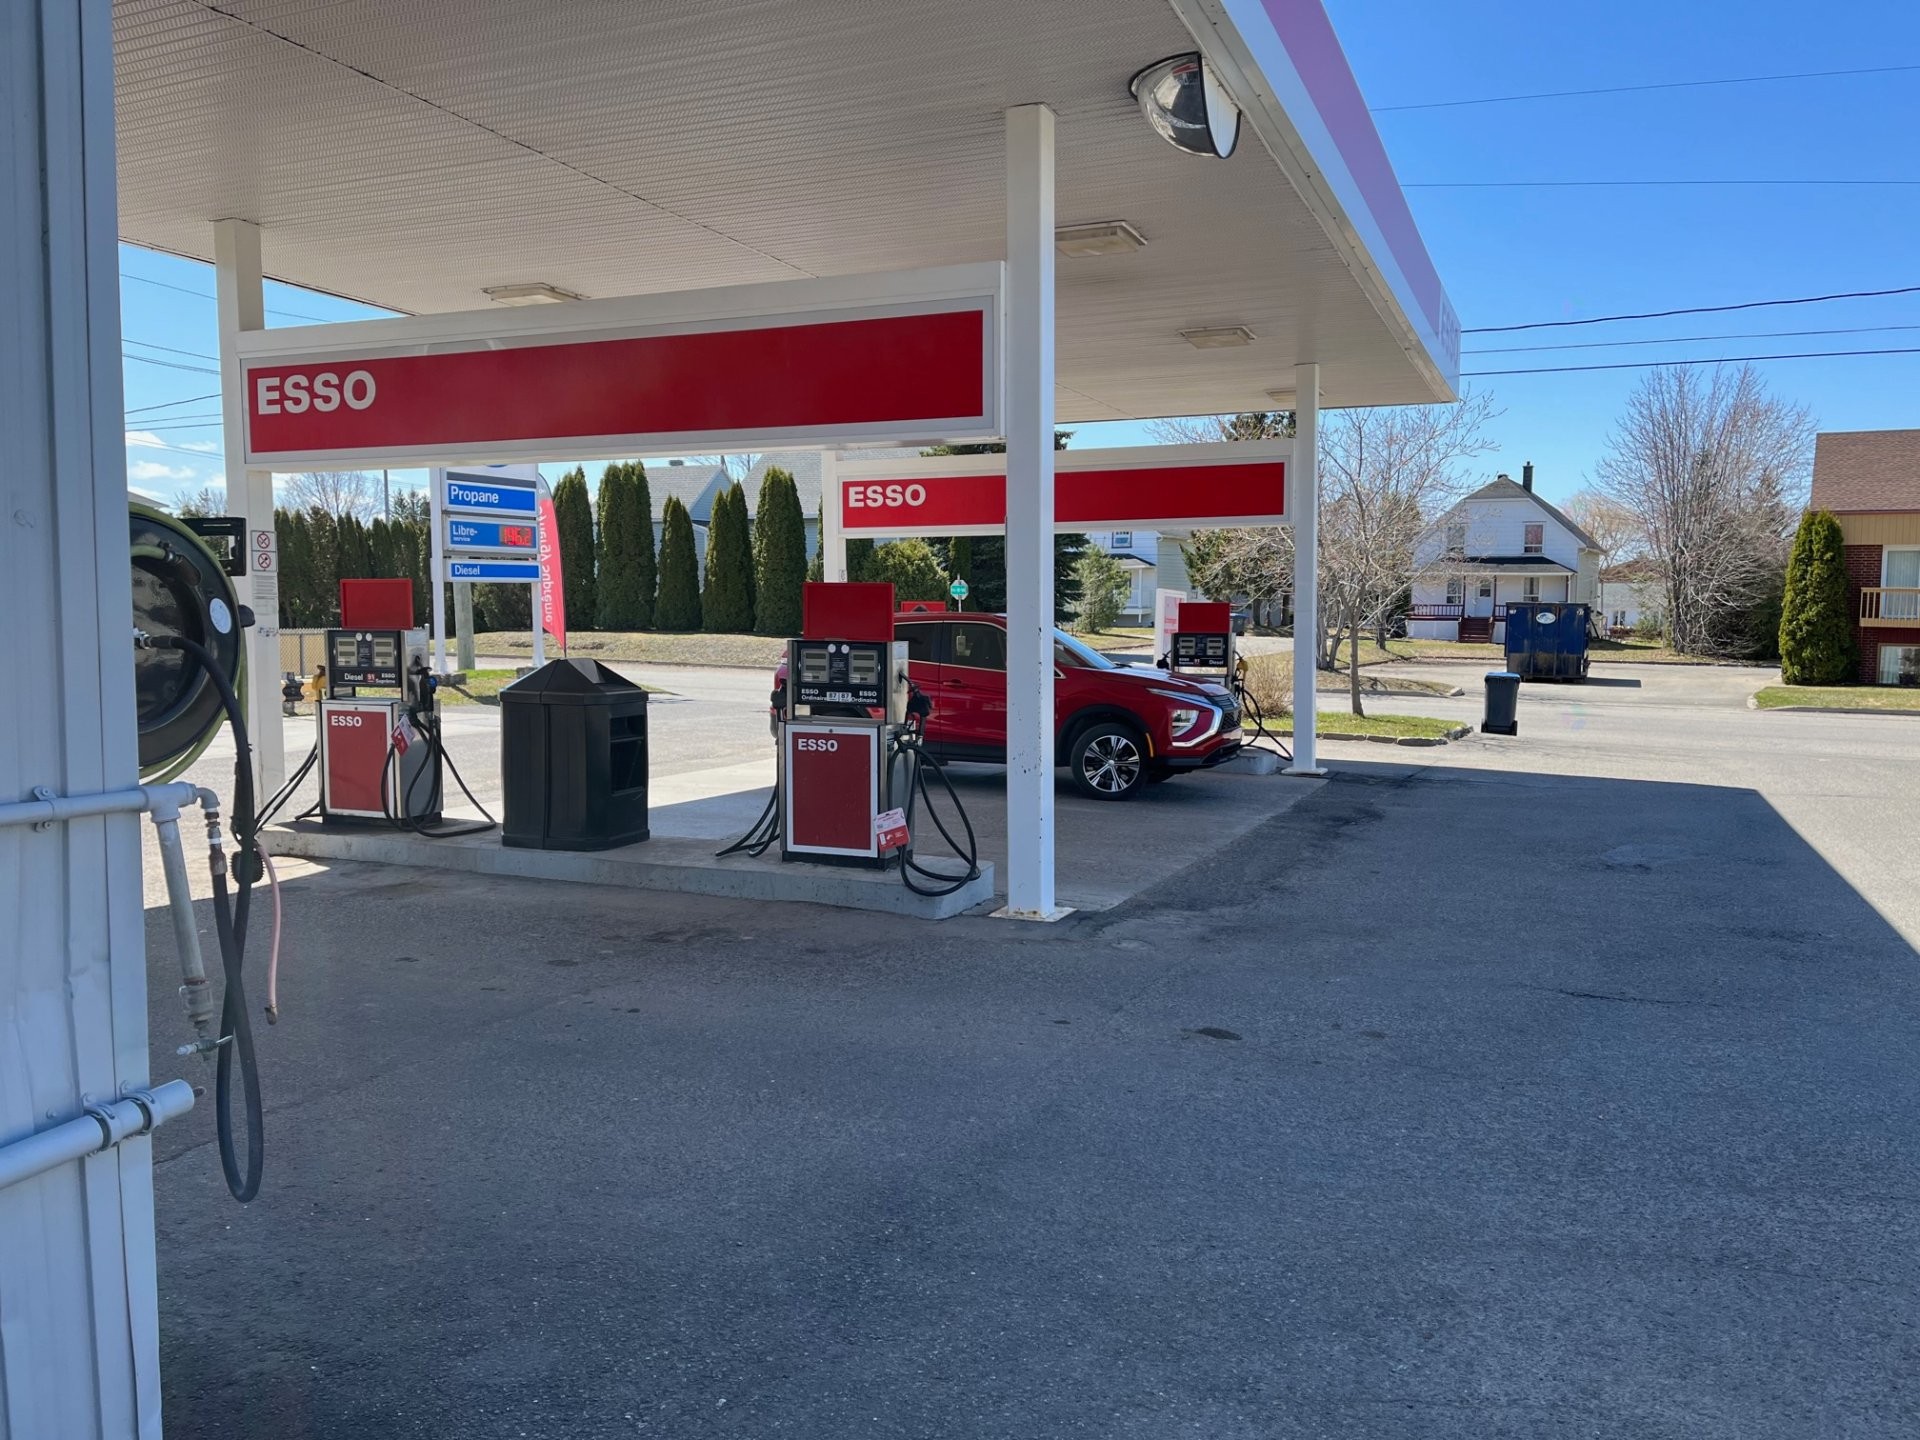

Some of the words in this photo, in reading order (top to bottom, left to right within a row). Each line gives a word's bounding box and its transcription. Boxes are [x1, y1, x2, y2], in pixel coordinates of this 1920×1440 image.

[256, 369, 377, 415] ESSO
[450, 485, 500, 504] Propane
[848, 483, 927, 508] ESSO
[452, 524, 478, 536] Libre-
[454, 564, 481, 576] Diesel
[344, 672, 364, 680] Diesel
[330, 715, 363, 727] ESSO
[797, 738, 838, 752] ESSO
